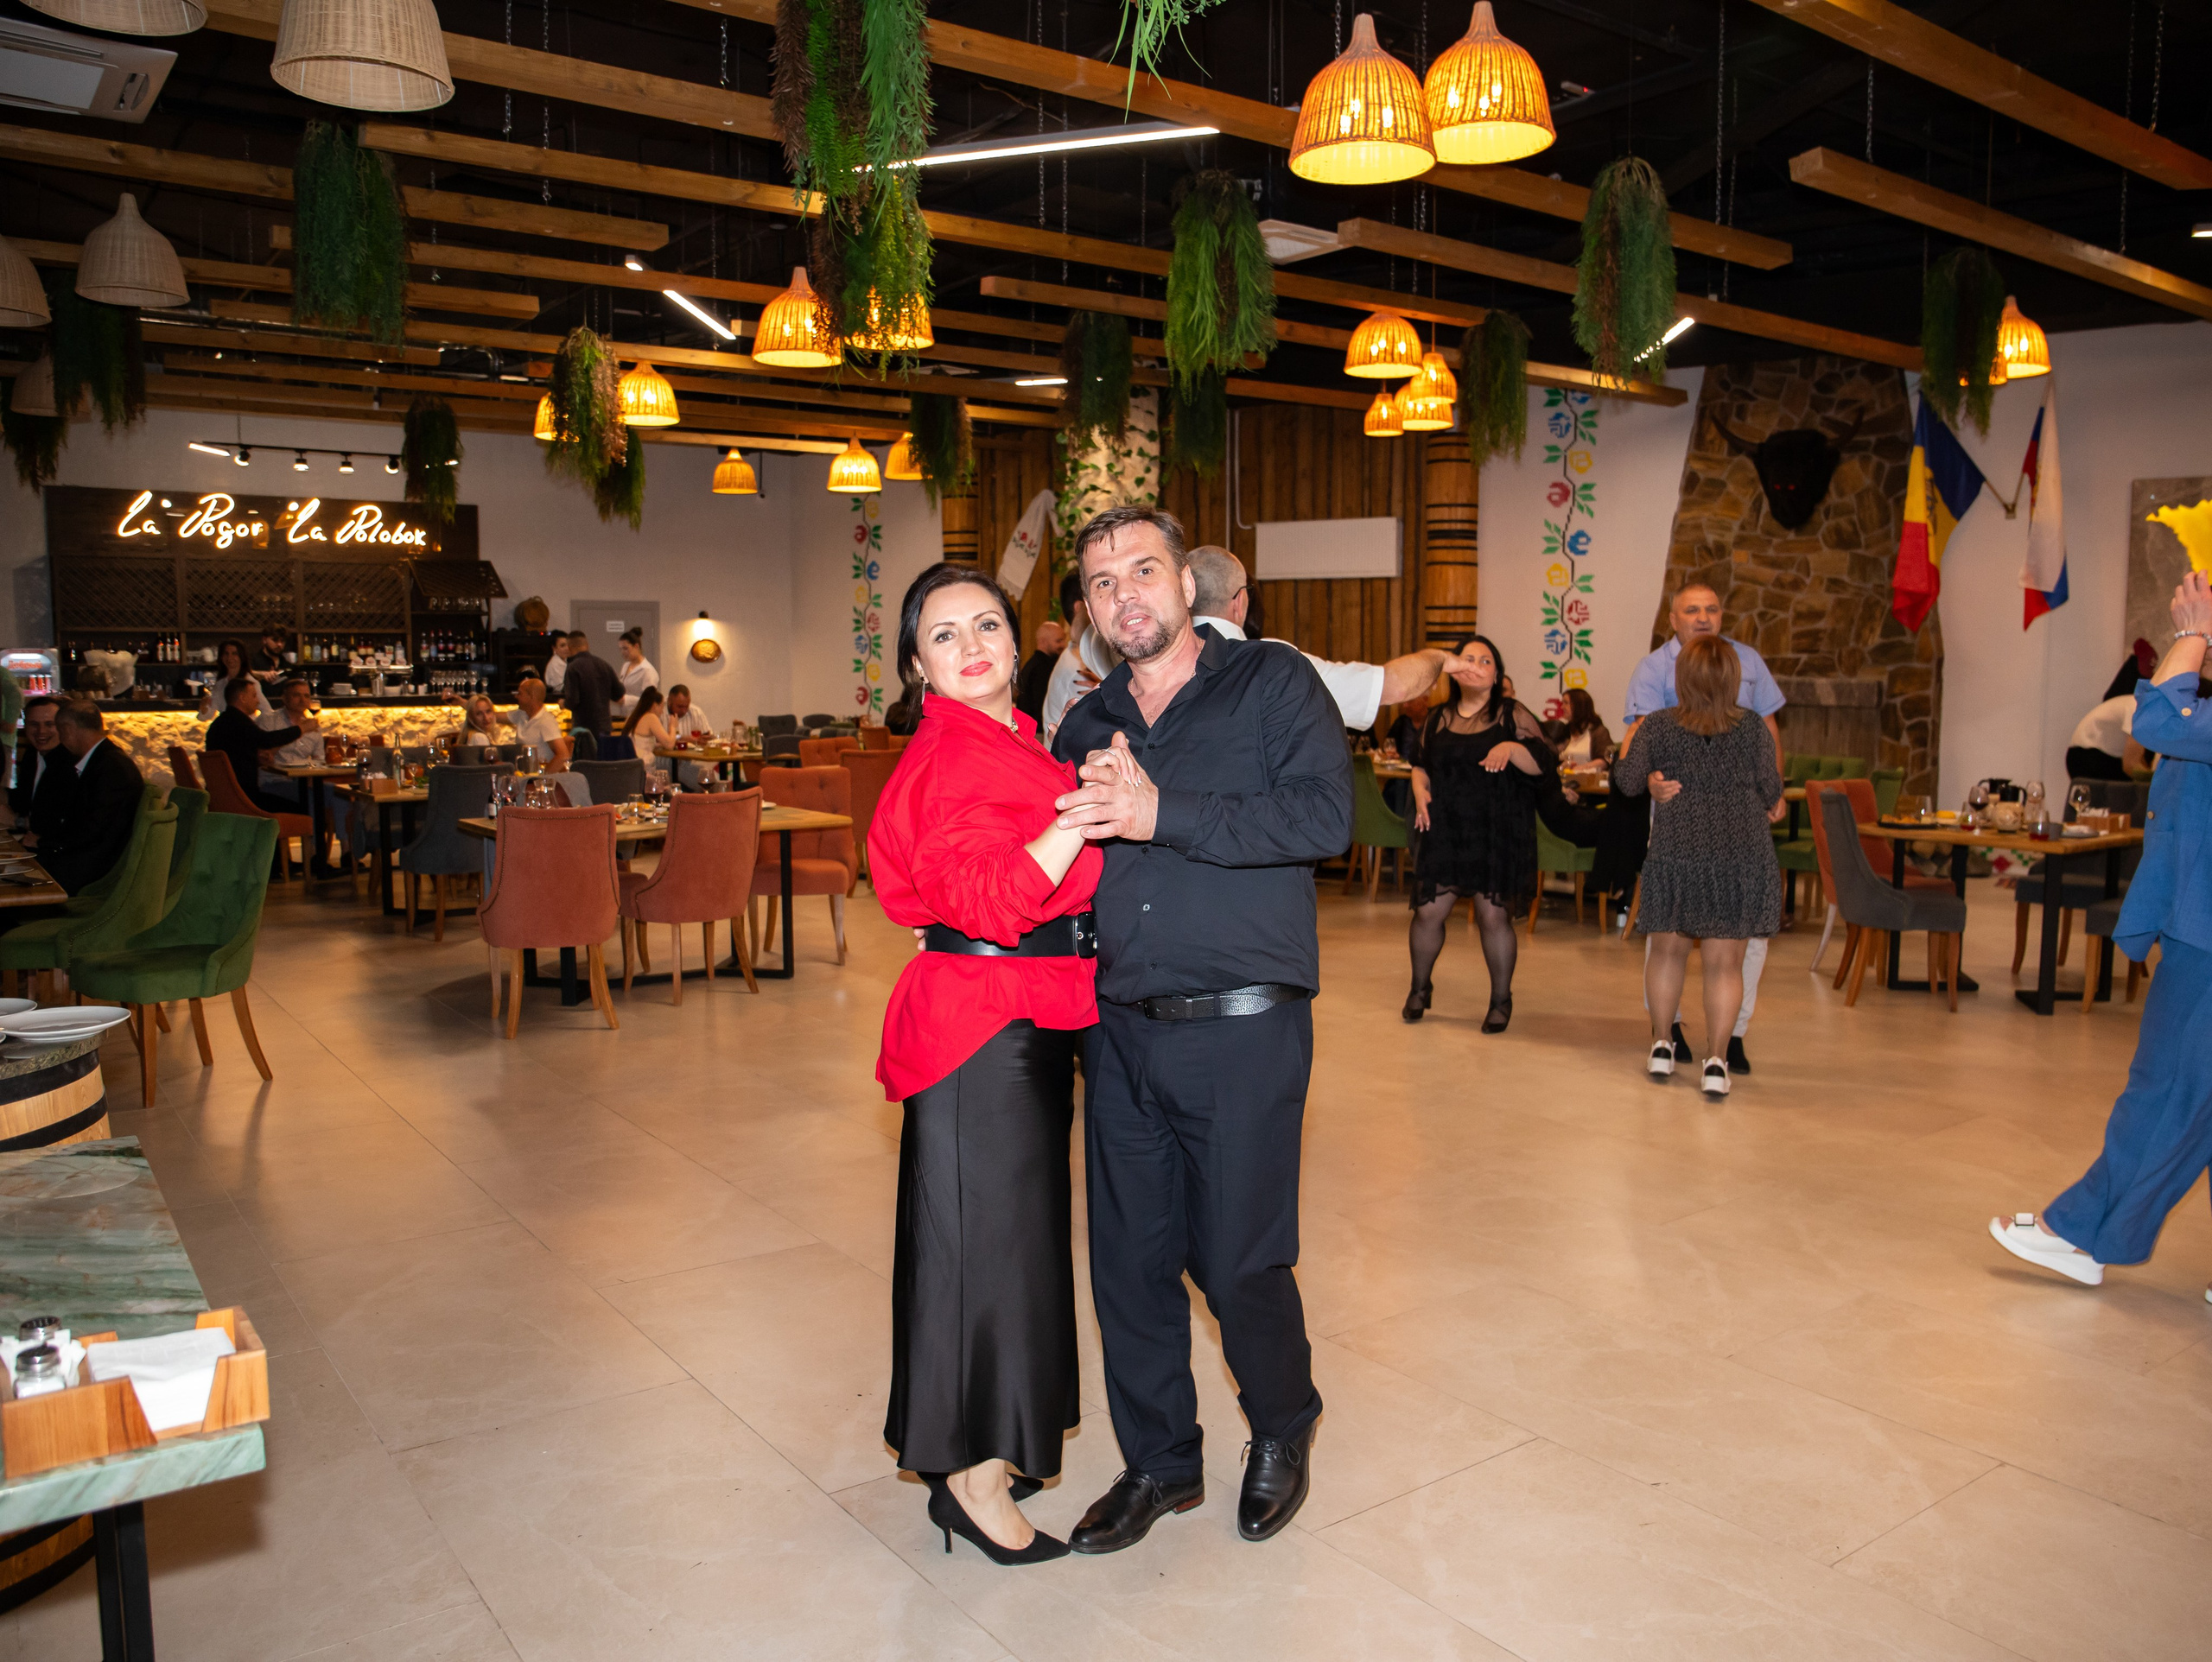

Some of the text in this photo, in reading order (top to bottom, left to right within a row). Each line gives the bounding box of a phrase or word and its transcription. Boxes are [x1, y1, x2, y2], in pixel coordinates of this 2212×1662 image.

[118, 490, 161, 537] La
[178, 492, 264, 549] Pogor
[287, 498, 327, 544] La
